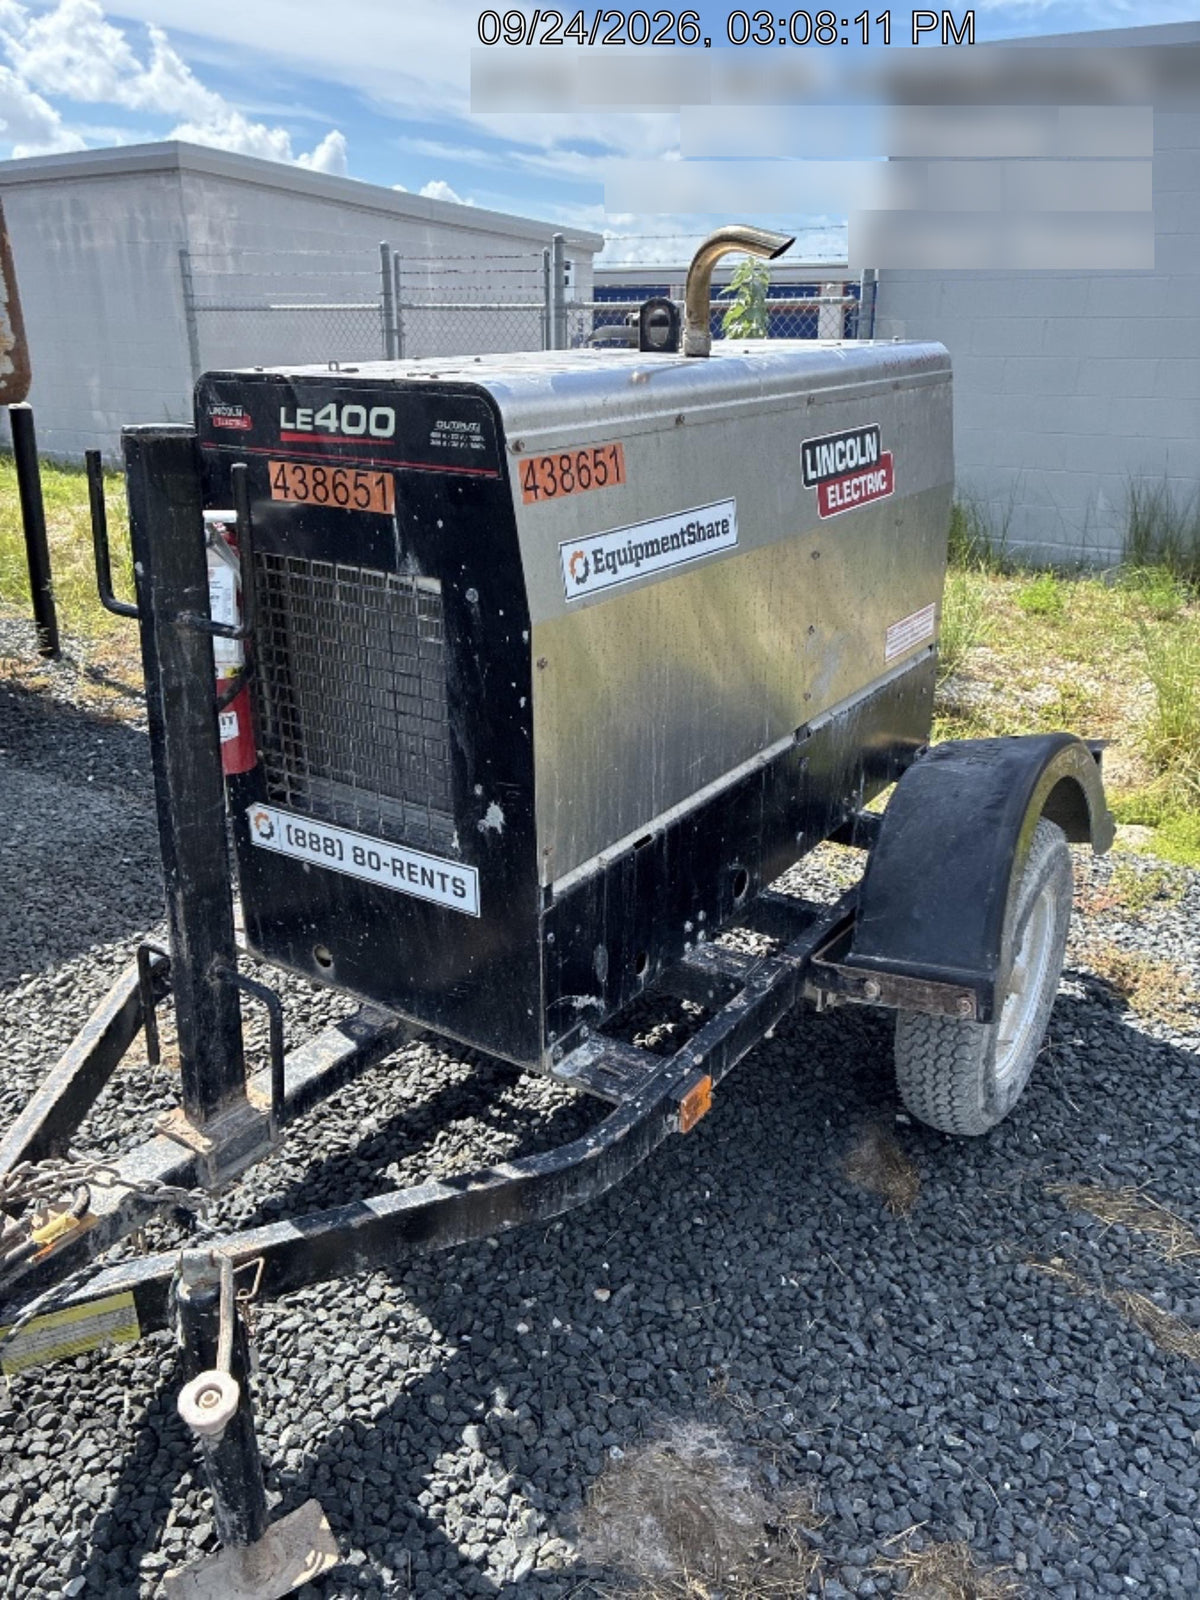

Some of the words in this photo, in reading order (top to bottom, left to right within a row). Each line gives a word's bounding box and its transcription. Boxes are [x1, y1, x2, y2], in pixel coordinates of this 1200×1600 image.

[279, 403, 396, 438] LE400
[524, 445, 620, 499] 438651
[805, 432, 877, 480] LINCOLN
[272, 463, 389, 511] 438651
[827, 469, 887, 509] ELECTRIC
[591, 517, 730, 575] EquipmentShare
[286, 824, 343, 861] (888)
[353, 846, 467, 898] 80-RENTS
